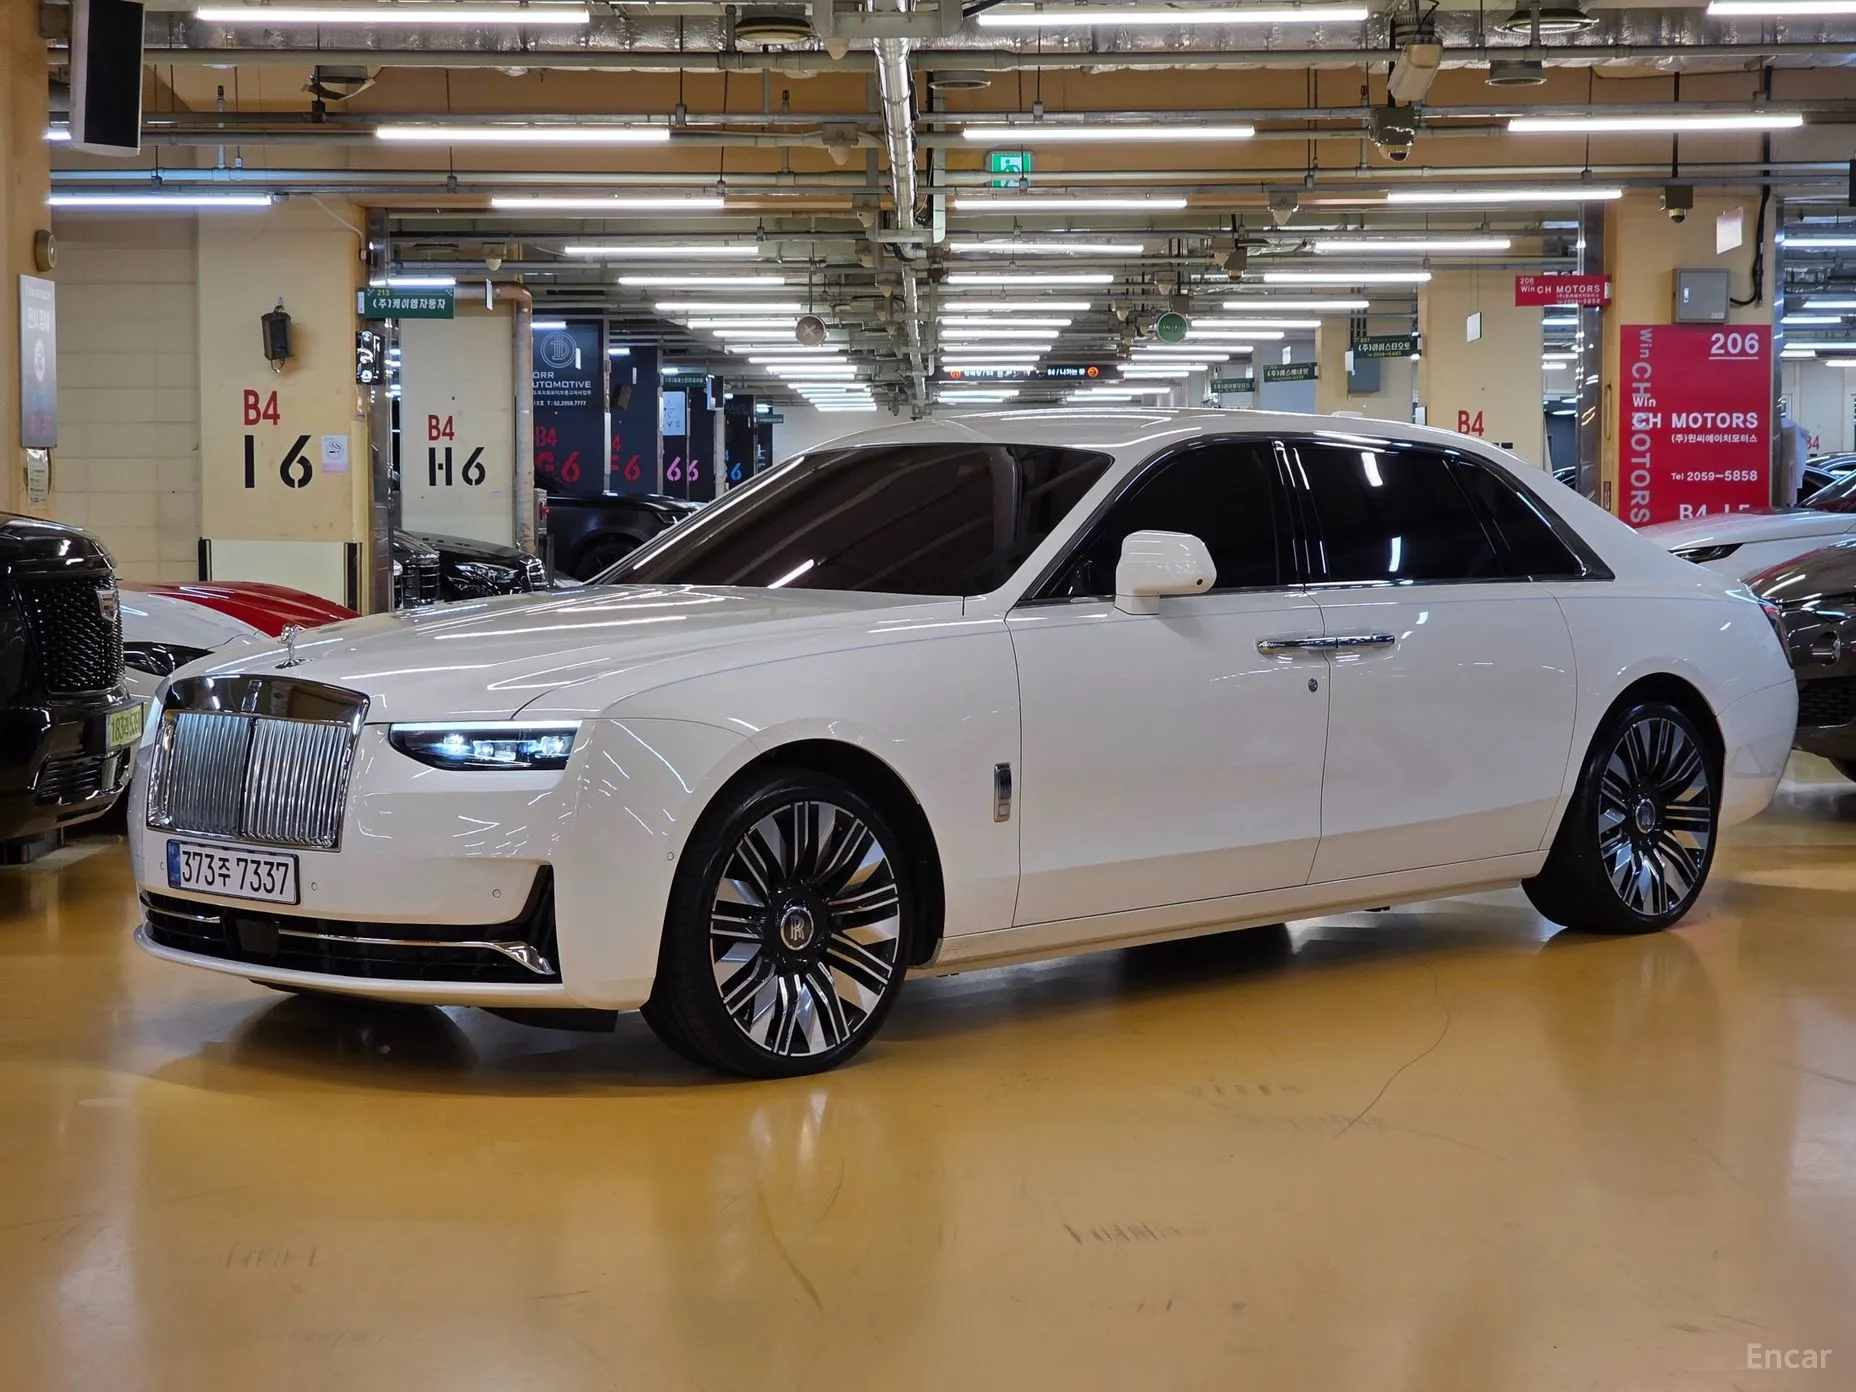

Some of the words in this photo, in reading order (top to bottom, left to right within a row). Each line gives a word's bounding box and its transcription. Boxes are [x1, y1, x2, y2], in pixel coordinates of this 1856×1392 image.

[1520, 277, 1534, 285] 206
[1520, 285, 1535, 293] Win
[1537, 285, 1552, 294] CH
[1556, 284, 1601, 293] MOTORS
[1640, 328, 1652, 359] Win
[1710, 332, 1760, 354] 206
[532, 370, 555, 379] ÖRR
[1631, 361, 1652, 398] CH
[532, 380, 592, 389] UTOMOTIVE
[243, 389, 281, 426] B4
[1632, 396, 1657, 408] Win
[428, 414, 455, 441] B4
[1458, 409, 1485, 437] B4
[1632, 412, 1662, 429] CH
[1671, 412, 1759, 429] MOTORS
[612, 435, 621, 451] 4
[1671, 433, 1758, 444] (주)윈씨에이치모터스
[1671, 472, 1684, 481] Tel
[1686, 470, 1758, 482] 2059-5858
[182, 850, 231, 888] 373주
[236, 857, 290, 896] 7337
